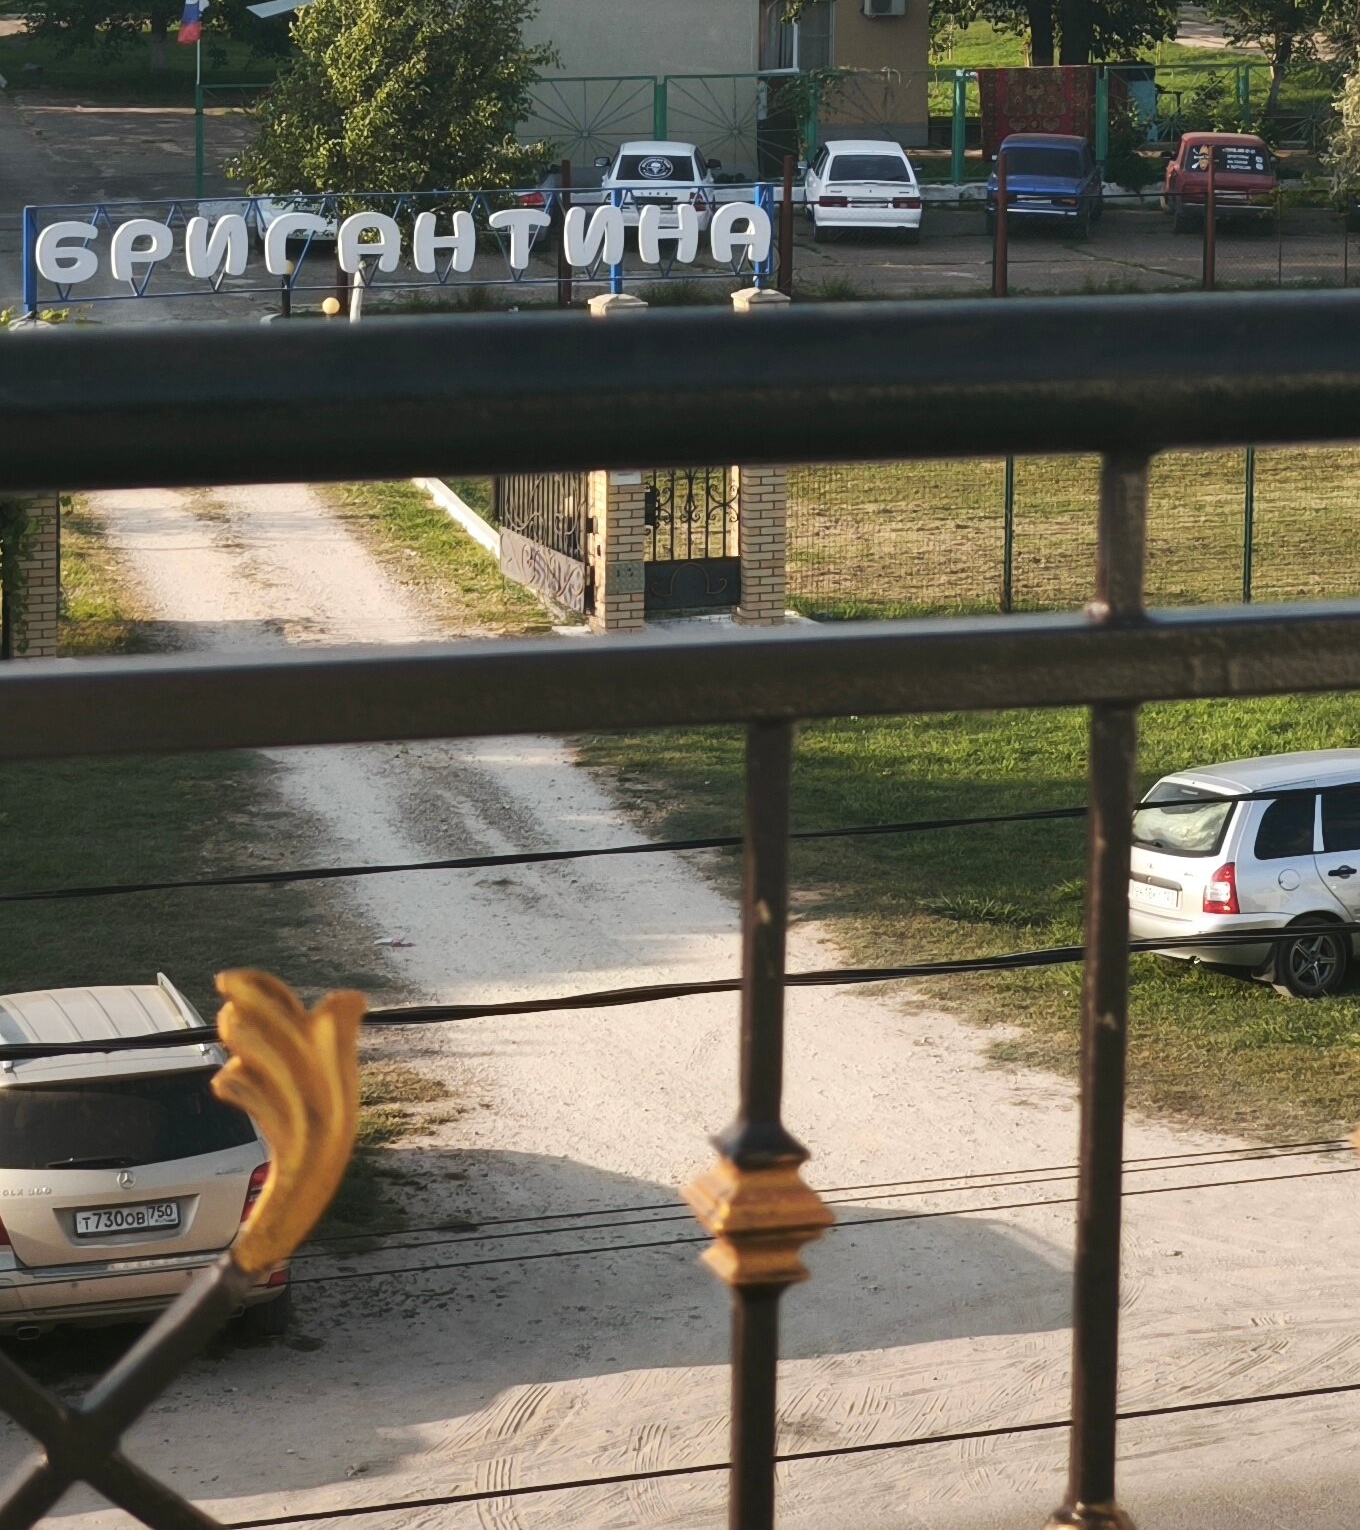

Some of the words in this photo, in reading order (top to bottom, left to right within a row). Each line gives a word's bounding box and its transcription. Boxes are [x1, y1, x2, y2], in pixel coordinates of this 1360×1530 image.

[35, 201, 772, 284] БРИГАНТИНА
[81, 1210, 146, 1231] Т730ОВ
[149, 1203, 174, 1220] 750
